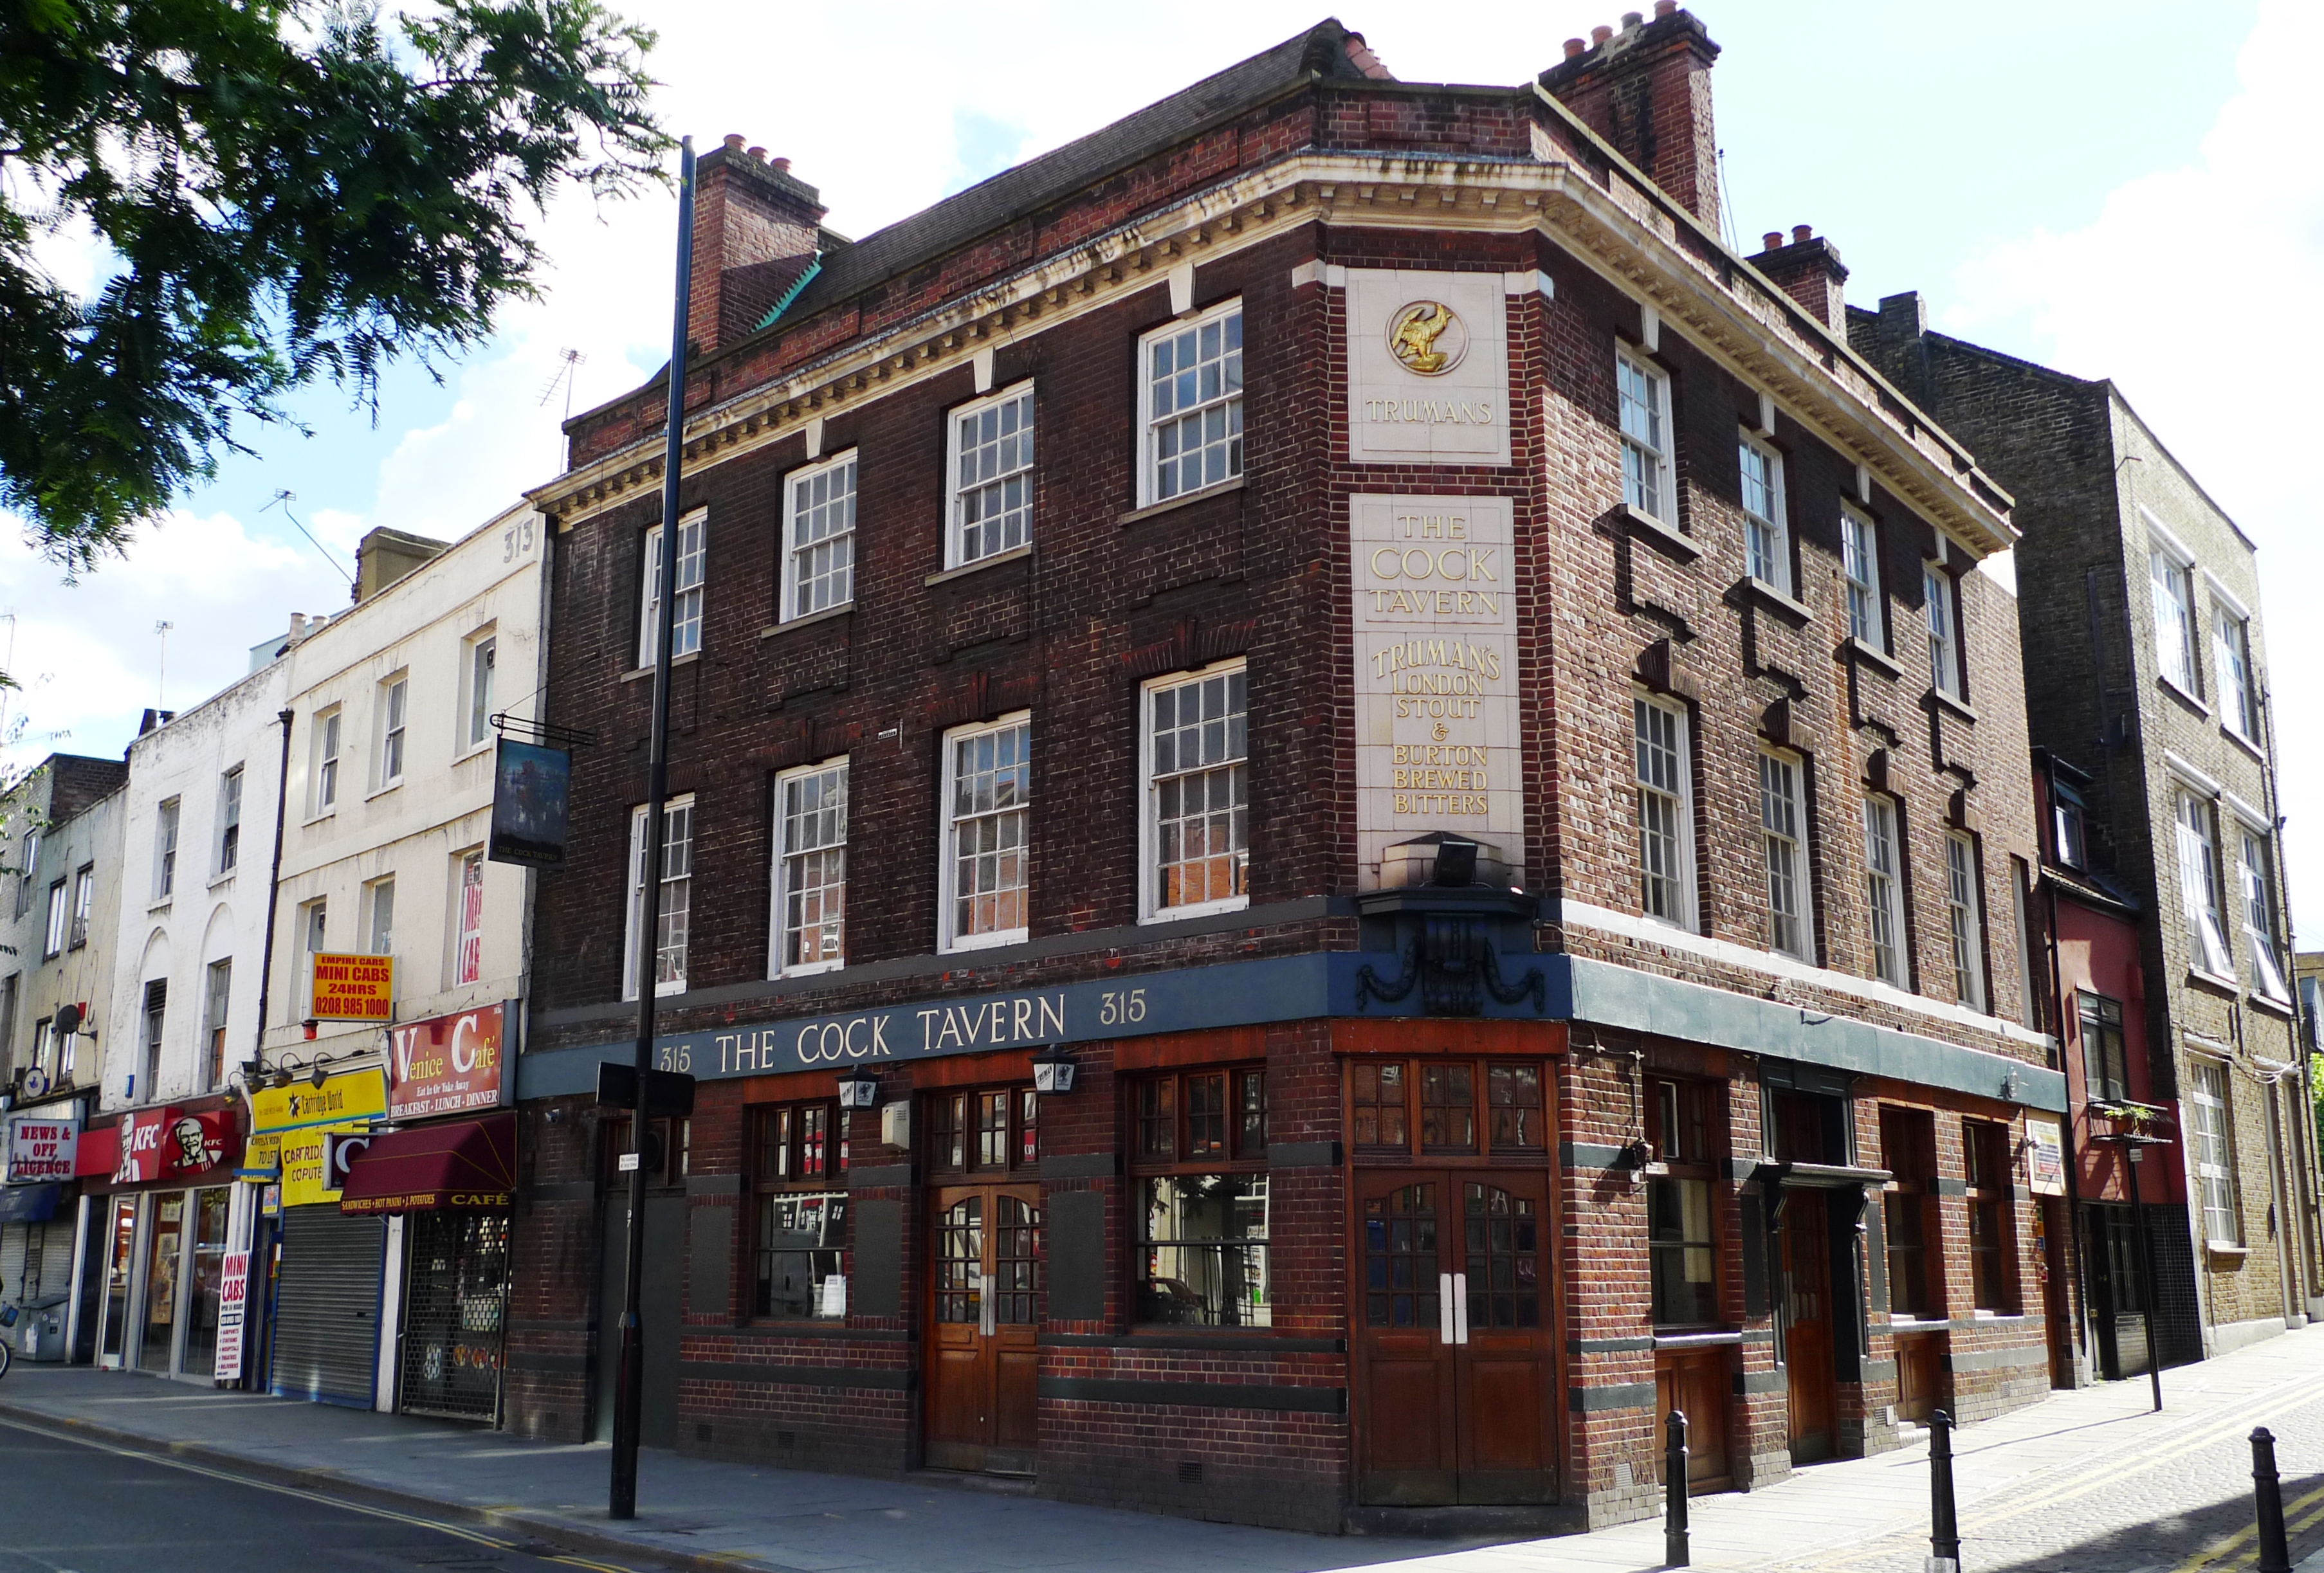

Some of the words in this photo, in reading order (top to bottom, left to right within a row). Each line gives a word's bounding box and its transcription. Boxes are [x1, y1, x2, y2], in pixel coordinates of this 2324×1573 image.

[1366, 399, 1492, 424] TRUMANS
[1398, 515, 1466, 539] THE
[503, 518, 535, 563] 313
[1370, 547, 1497, 581] COCK
[1369, 590, 1498, 615] TAVERN
[1371, 639, 1500, 680] TRUMAN'S
[1392, 673, 1483, 695] LONDON
[1396, 697, 1481, 718] STOUT
[1431, 721, 1449, 741] &
[1392, 745, 1488, 766] BURTON
[1393, 769, 1488, 790] BREWED
[1393, 794, 1488, 814] BITTERS
[499, 846, 511, 854] THE
[515, 848, 531, 857] COCK
[533, 851, 558, 861] TAVERN
[322, 956, 356, 965] EMPIRE
[360, 958, 385, 966] CARS
[316, 966, 349, 980] MINI
[352, 967, 389, 982] CABS
[328, 983, 377, 995] 24HRS
[315, 997, 342, 1014] 0208
[343, 997, 362, 1015] 985
[365, 999, 389, 1015] 1000
[660, 1045, 691, 1072] 315
[715, 1030, 775, 1073] THE
[797, 1015, 892, 1064] COCK
[917, 994, 1065, 1050] TAVERN
[1100, 988, 1146, 1025] 315
[394, 1027, 443, 1082] Venice
[434, 1084, 441, 1094] Or
[302, 1093, 326, 1116] Cartridge
[327, 1088, 343, 1111] World
[390, 1100, 430, 1118] BREAKFAST
[435, 1095, 462, 1111] LUNCH
[466, 1089, 497, 1107] DINNER
[21, 1126, 57, 1140] NEWS
[62, 1127, 71, 1140] &
[132, 1123, 160, 1151] KFC
[204, 1138, 223, 1147] KFC
[33, 1143, 57, 1157] OFF
[16, 1160, 70, 1175] LICENCE
[342, 1199, 372, 1210] SANDWICHES
[375, 1198, 385, 1208] HOT
[386, 1197, 402, 1208] PANINI
[410, 1194, 435, 1205] POTATOES
[451, 1193, 509, 1205] CAFÉ
[224, 1254, 247, 1278] MINI
[222, 1278, 245, 1302] CABS
